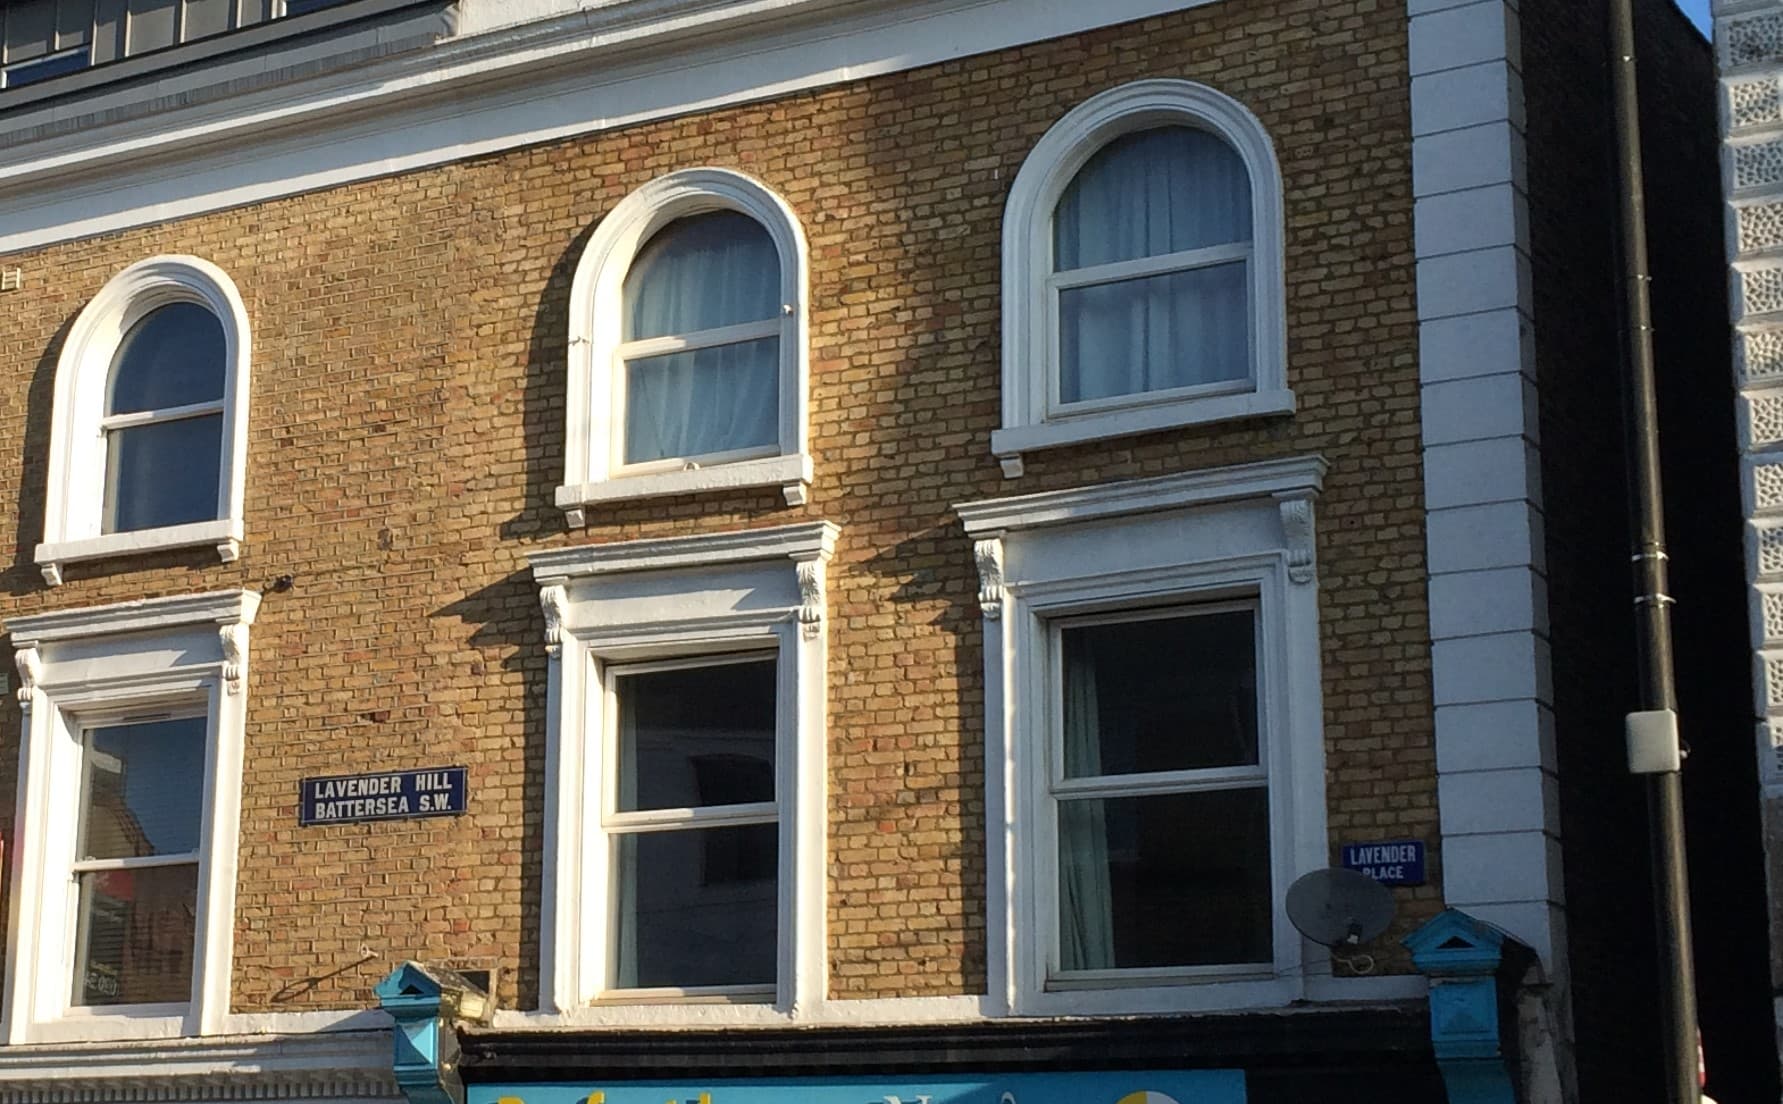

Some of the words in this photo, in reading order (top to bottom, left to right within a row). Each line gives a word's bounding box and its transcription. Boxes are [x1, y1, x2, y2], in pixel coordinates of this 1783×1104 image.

[315, 777, 401, 799] LAVENDER
[415, 773, 452, 791] HILL
[315, 797, 409, 819] BATTERSEA
[419, 794, 452, 812] S.W.
[1350, 845, 1416, 866] LAVENDER
[1362, 866, 1404, 880] PLACE
